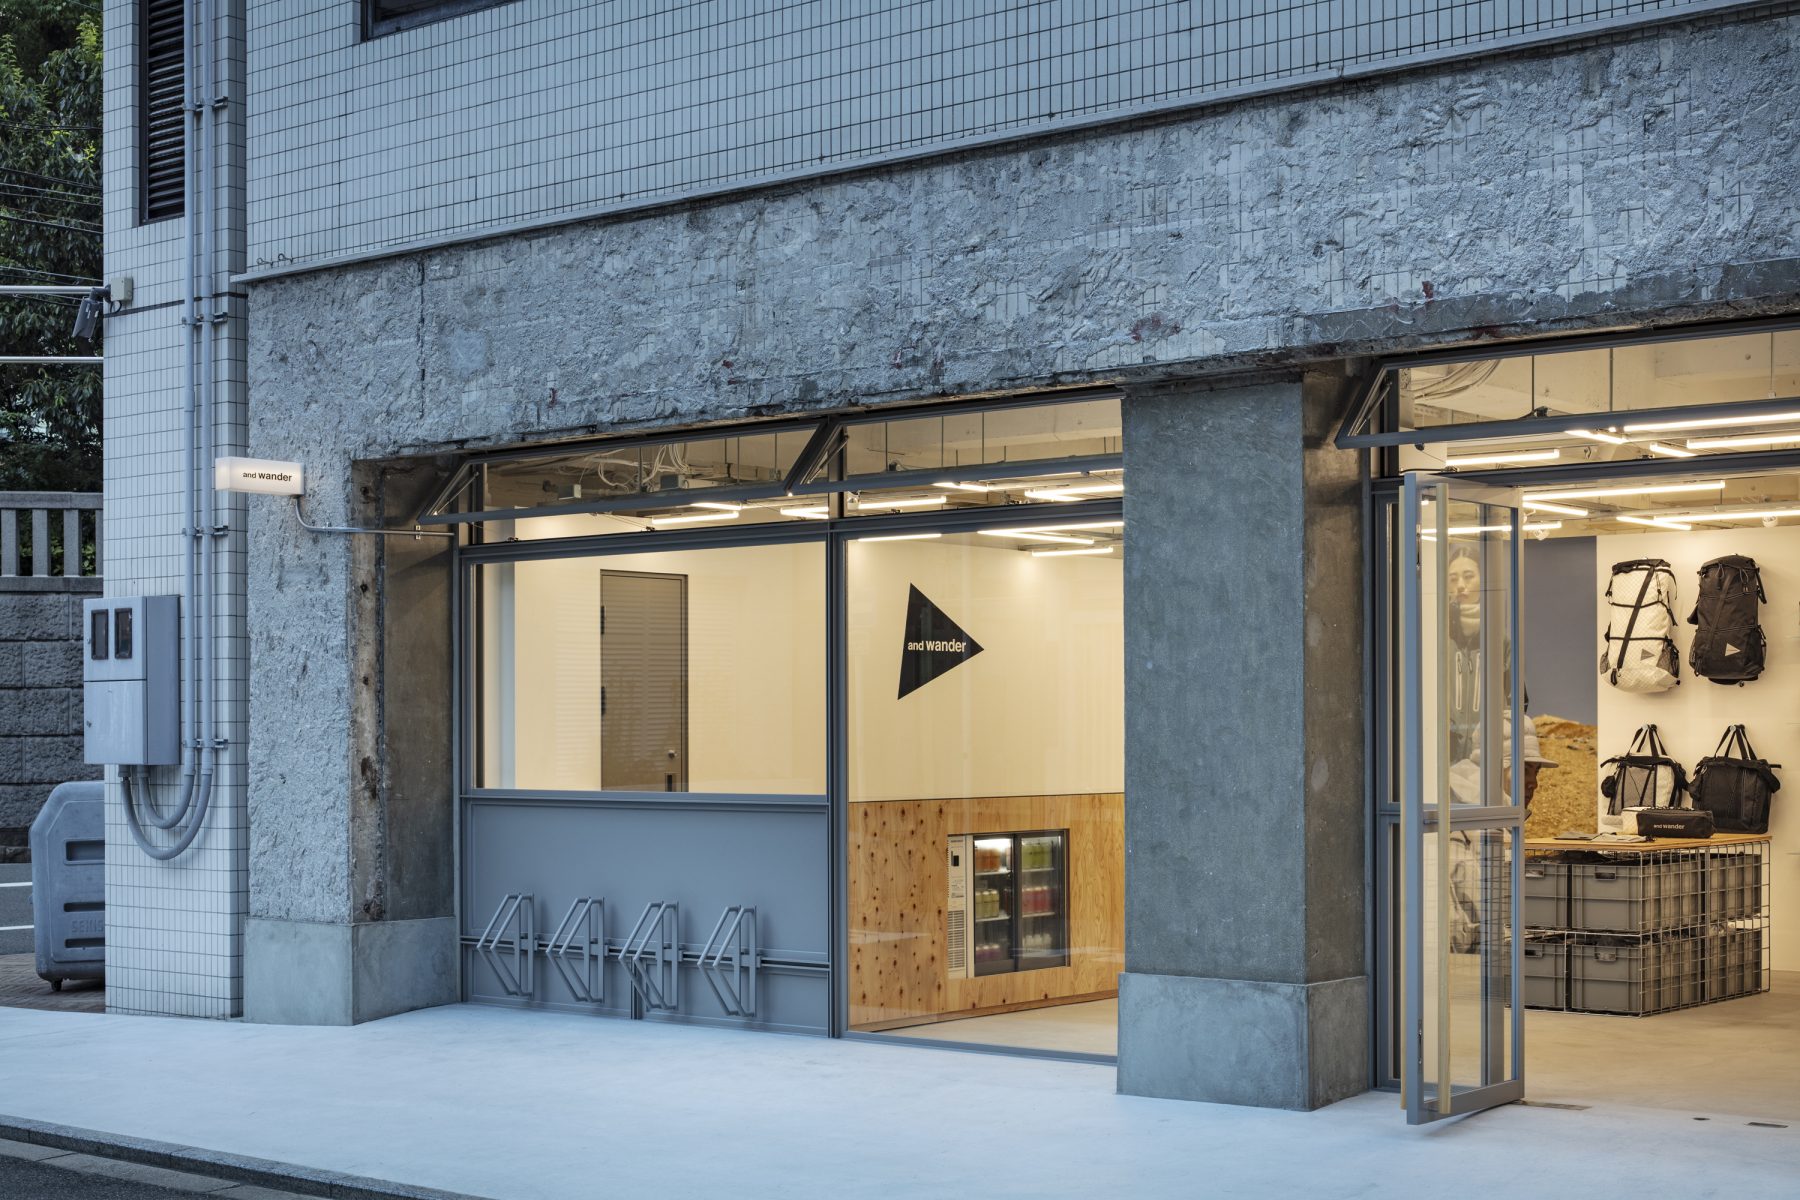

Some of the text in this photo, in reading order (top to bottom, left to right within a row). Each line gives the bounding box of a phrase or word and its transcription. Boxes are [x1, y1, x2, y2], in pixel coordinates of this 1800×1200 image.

[258, 472, 293, 482] wander
[907, 638, 966, 653] and wander
